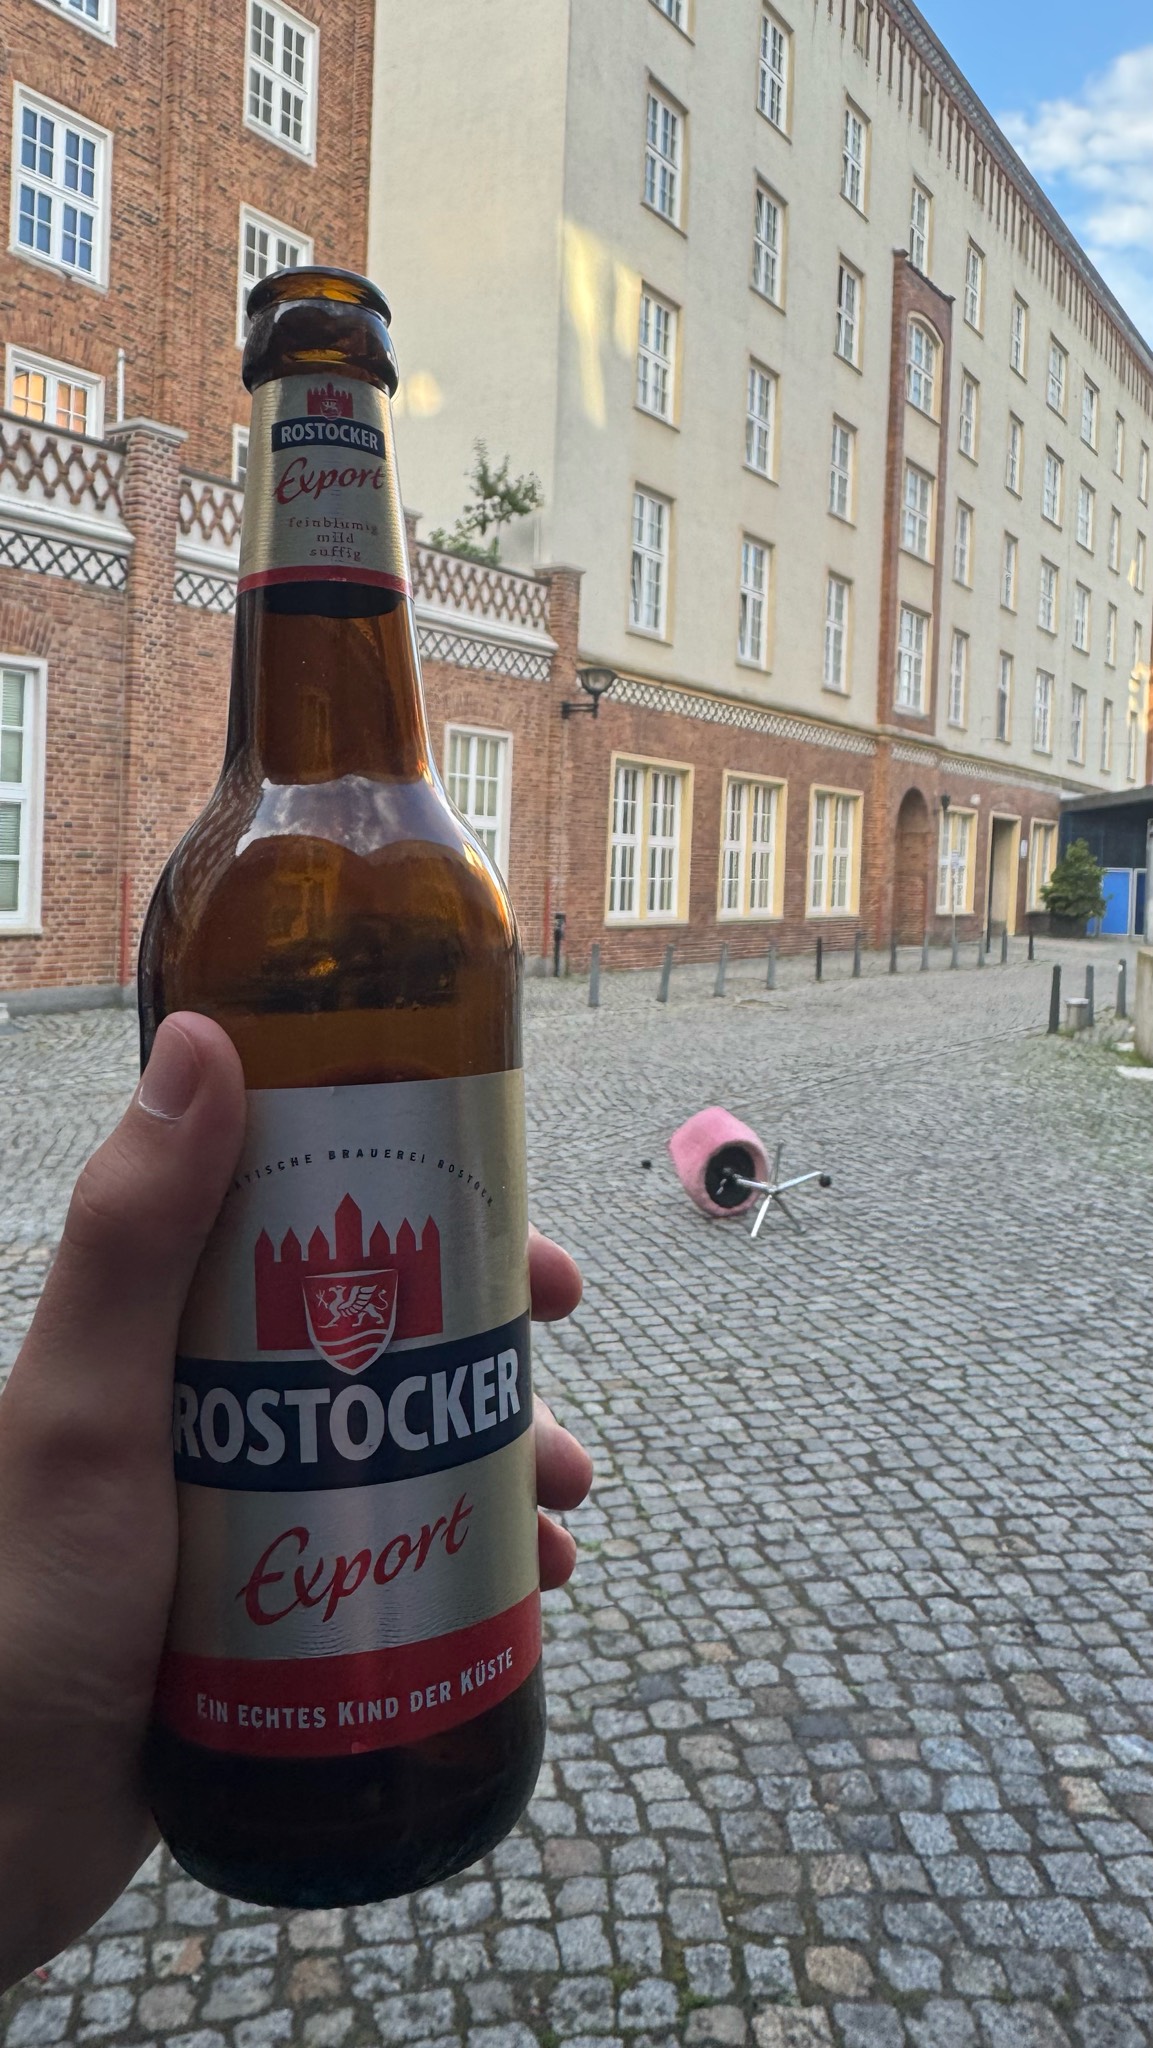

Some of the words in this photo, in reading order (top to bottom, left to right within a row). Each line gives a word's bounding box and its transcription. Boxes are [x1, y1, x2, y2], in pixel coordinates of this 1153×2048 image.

[281, 422, 378, 450] ROSTOCKER
[273, 457, 386, 504] Export
[317, 532, 355, 543] mild
[328, 1149, 425, 1164] BRAUEREI
[437, 1159, 493, 1208] ROSTOCK
[173, 1348, 521, 1466] ROSTOCKER
[236, 1492, 474, 1626] Export
[197, 1693, 228, 1724] EIN
[238, 1704, 327, 1729] ECHTES
[338, 1699, 400, 1726] KIND
[410, 1680, 452, 1713] DER
[460, 1647, 514, 1696] KÜSTE
